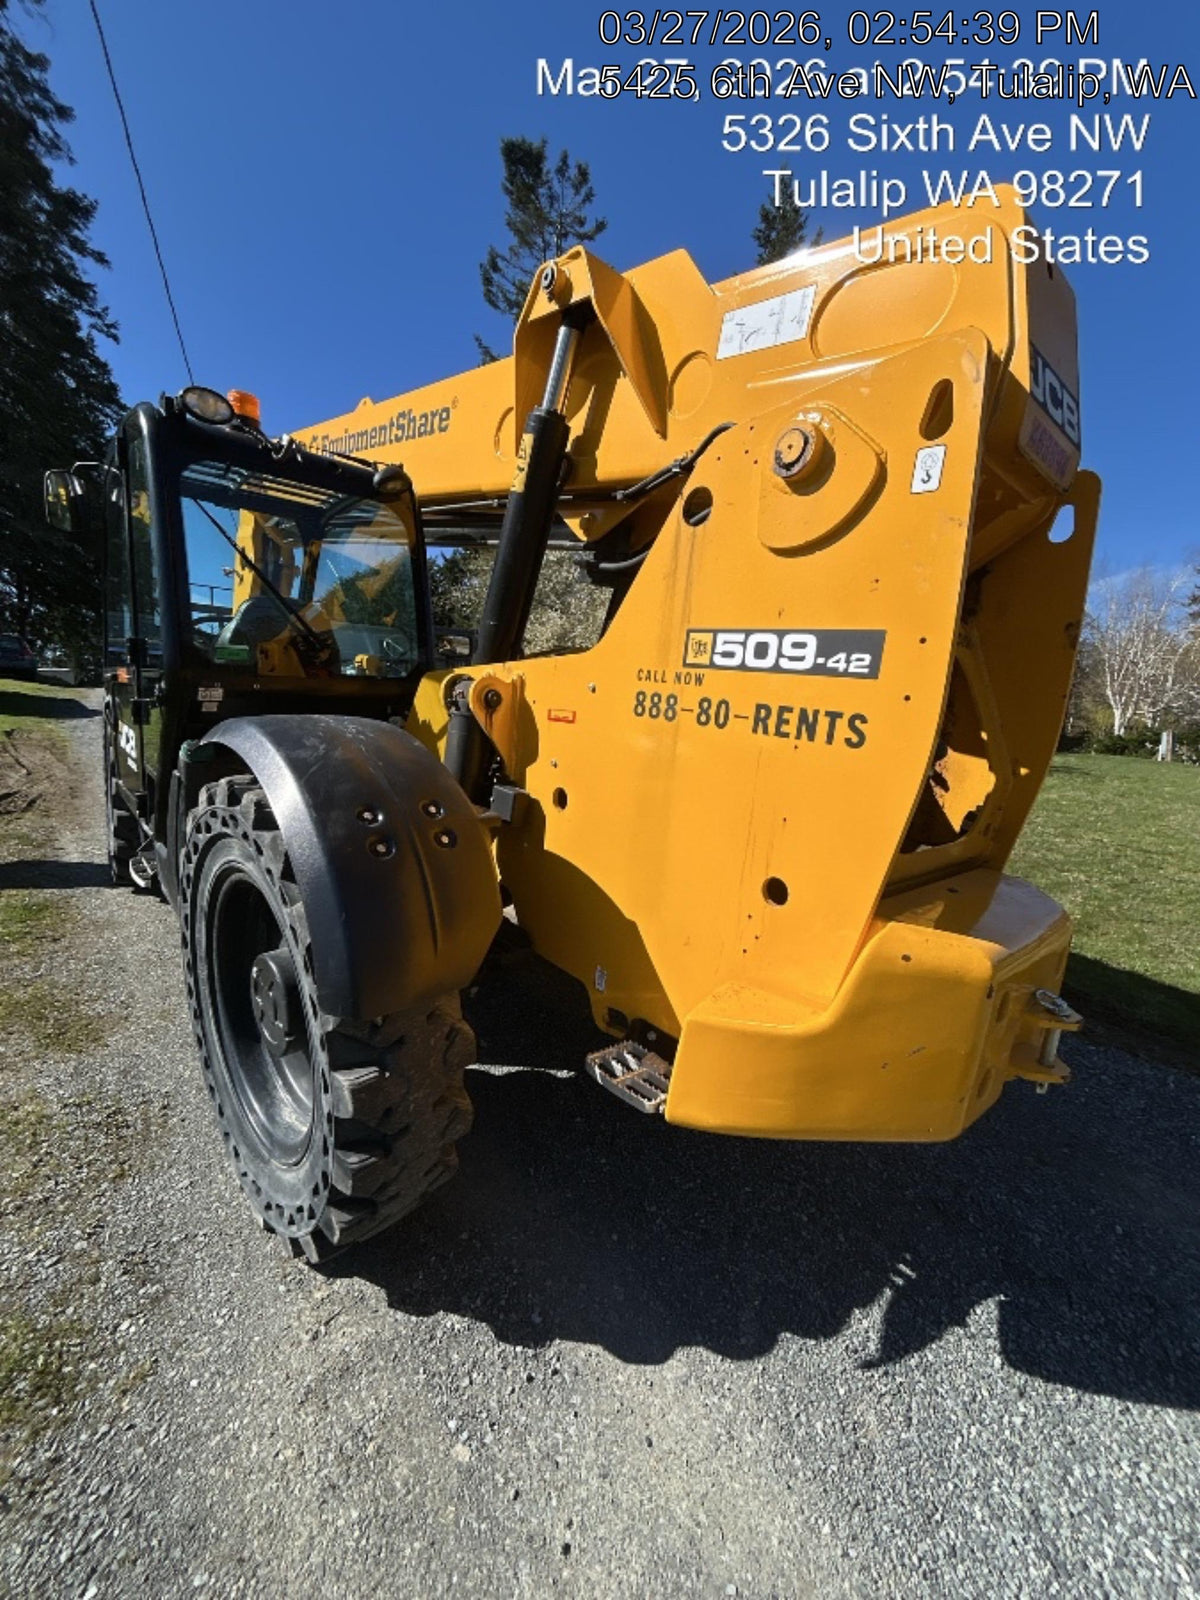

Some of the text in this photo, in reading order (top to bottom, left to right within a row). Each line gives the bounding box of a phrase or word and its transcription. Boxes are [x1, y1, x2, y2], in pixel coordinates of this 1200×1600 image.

[1031, 356, 1079, 445] JCB
[637, 668, 705, 687] CALL NOW
[712, 632, 872, 674] 509-42
[633, 690, 869, 750] 888-80-RENTS
